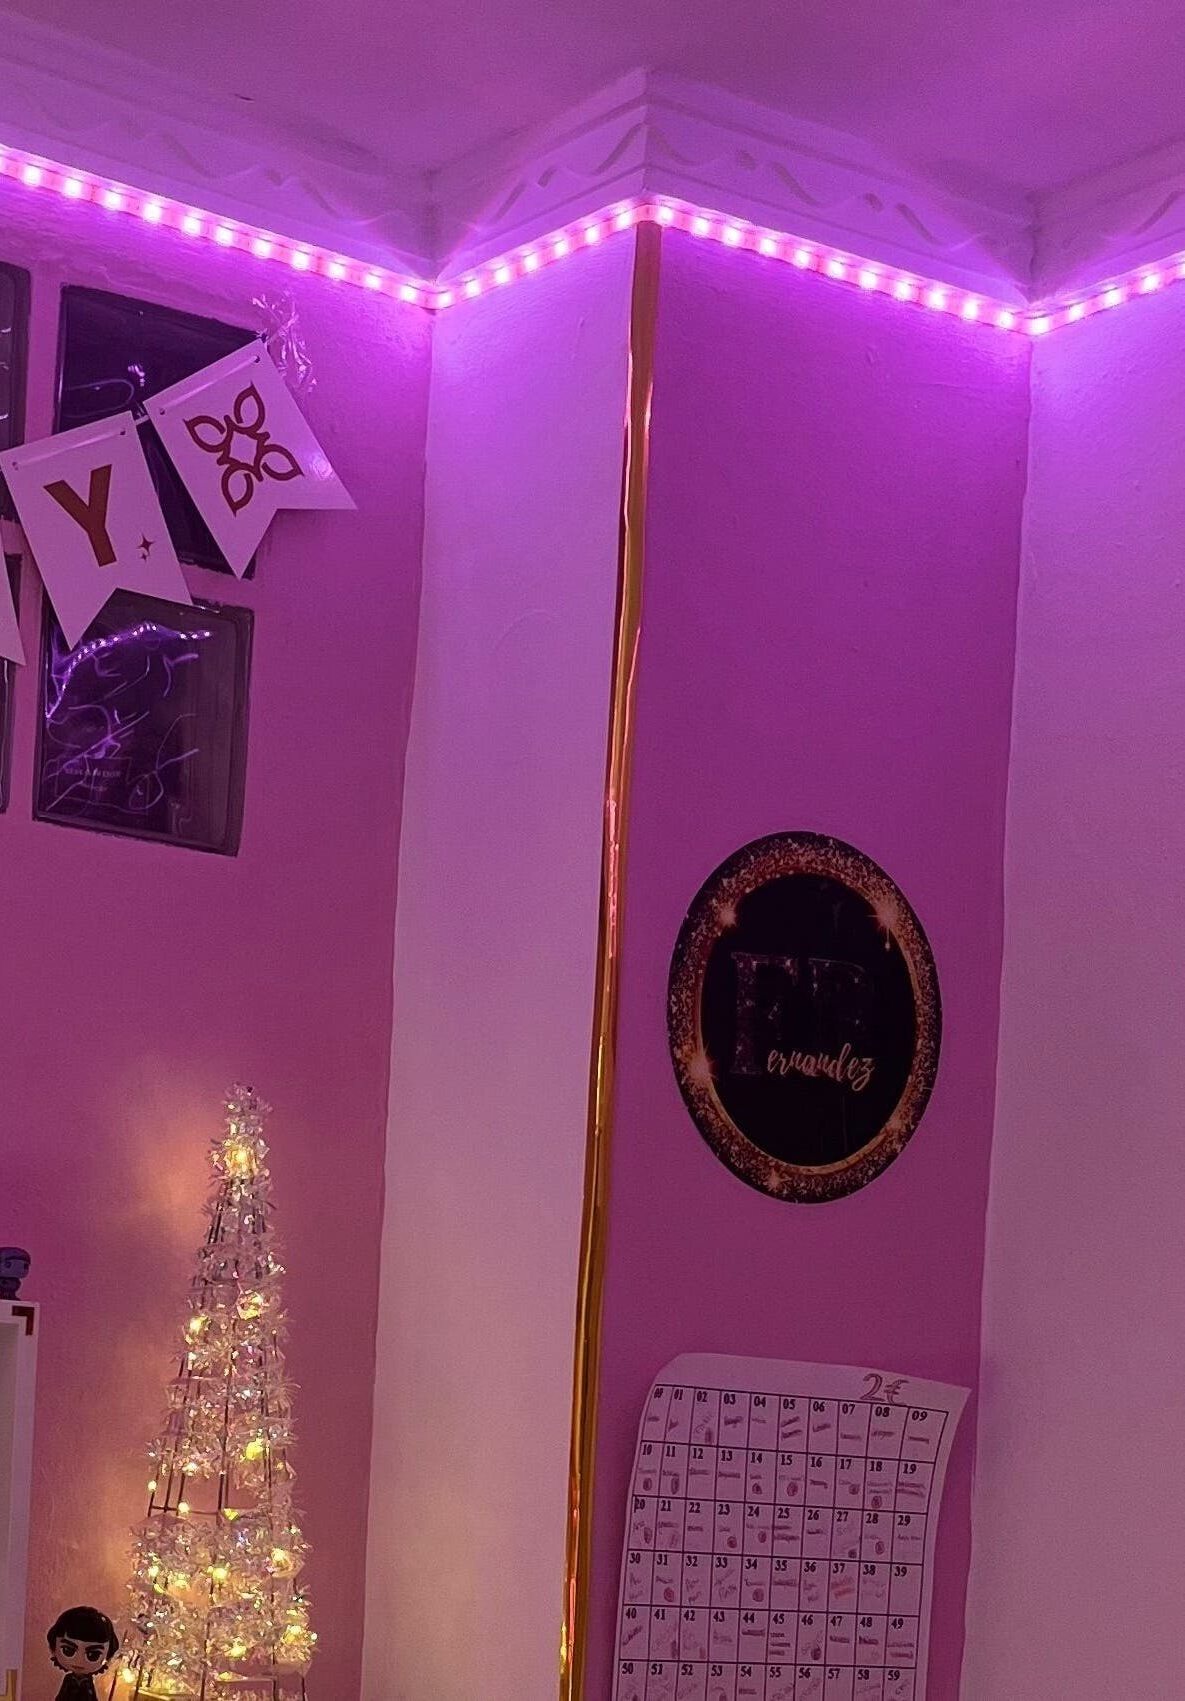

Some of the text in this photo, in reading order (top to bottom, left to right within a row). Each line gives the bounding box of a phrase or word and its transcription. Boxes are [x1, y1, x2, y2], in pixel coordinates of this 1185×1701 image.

[860, 1373, 910, 1405] 2€
[674, 1389, 683, 1400] 01
[697, 1391, 707, 1402] 02
[724, 1394, 736, 1404] 03
[754, 1396, 766, 1407] 04
[783, 1399, 795, 1409] 05
[813, 1401, 825, 1412] 06
[842, 1404, 855, 1414] 07
[875, 1407, 890, 1417] 08
[912, 1411, 927, 1421] 09
[643, 1444, 916, 1474] 10 11 12 13 14 15 16 17 18 19
[661, 1500, 671, 1511] 21
[689, 1502, 700, 1513] 22
[718, 1504, 730, 1515] 23
[748, 1506, 759, 1517] 24
[778, 1508, 789, 1518] 25
[807, 1510, 819, 1520] 26
[837, 1511, 848, 1521] 27
[866, 1513, 878, 1523] 28
[897, 1515, 910, 1525] 29
[630, 1553, 907, 1576] 30 31 32 33 34 35 36 37 38 39
[626, 1608, 903, 1628] 40 41 42 43 44 45 46 47 48 49
[622, 1663, 900, 1680] 50 51 52 53 54 55 56 57 58 59
